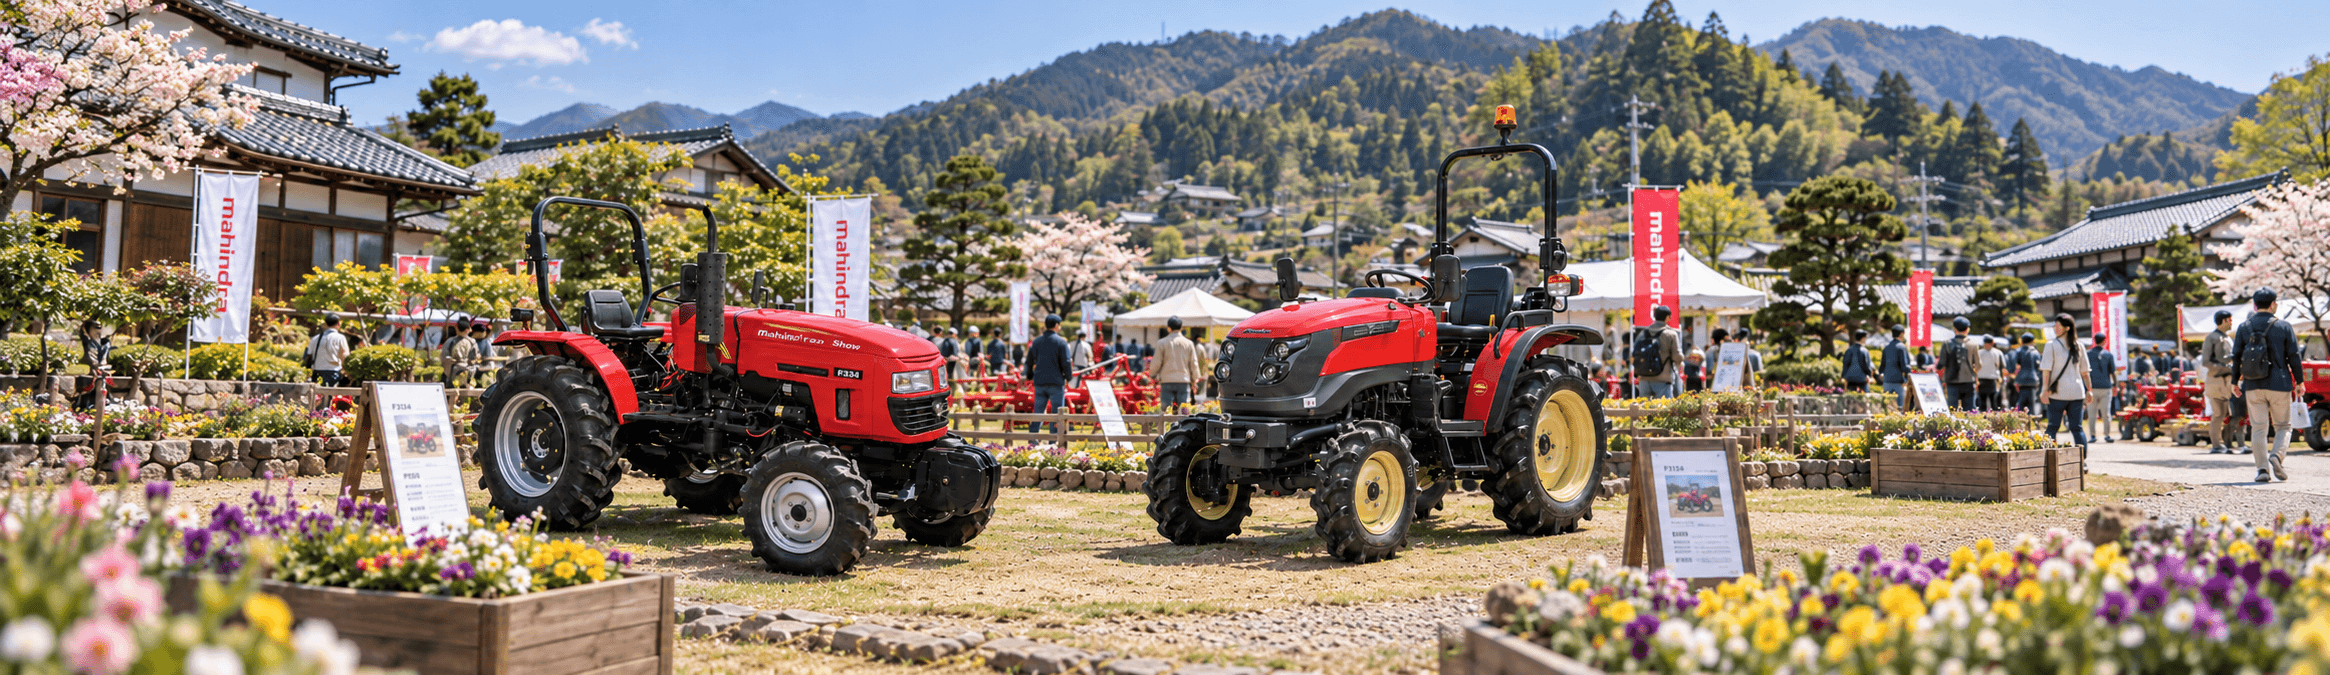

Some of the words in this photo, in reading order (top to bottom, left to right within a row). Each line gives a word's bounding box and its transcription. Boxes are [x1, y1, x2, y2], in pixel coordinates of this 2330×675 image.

[216, 197, 235, 313] mahindra
[835, 220, 850, 318] mahindra
[832, 339, 861, 351] Show
